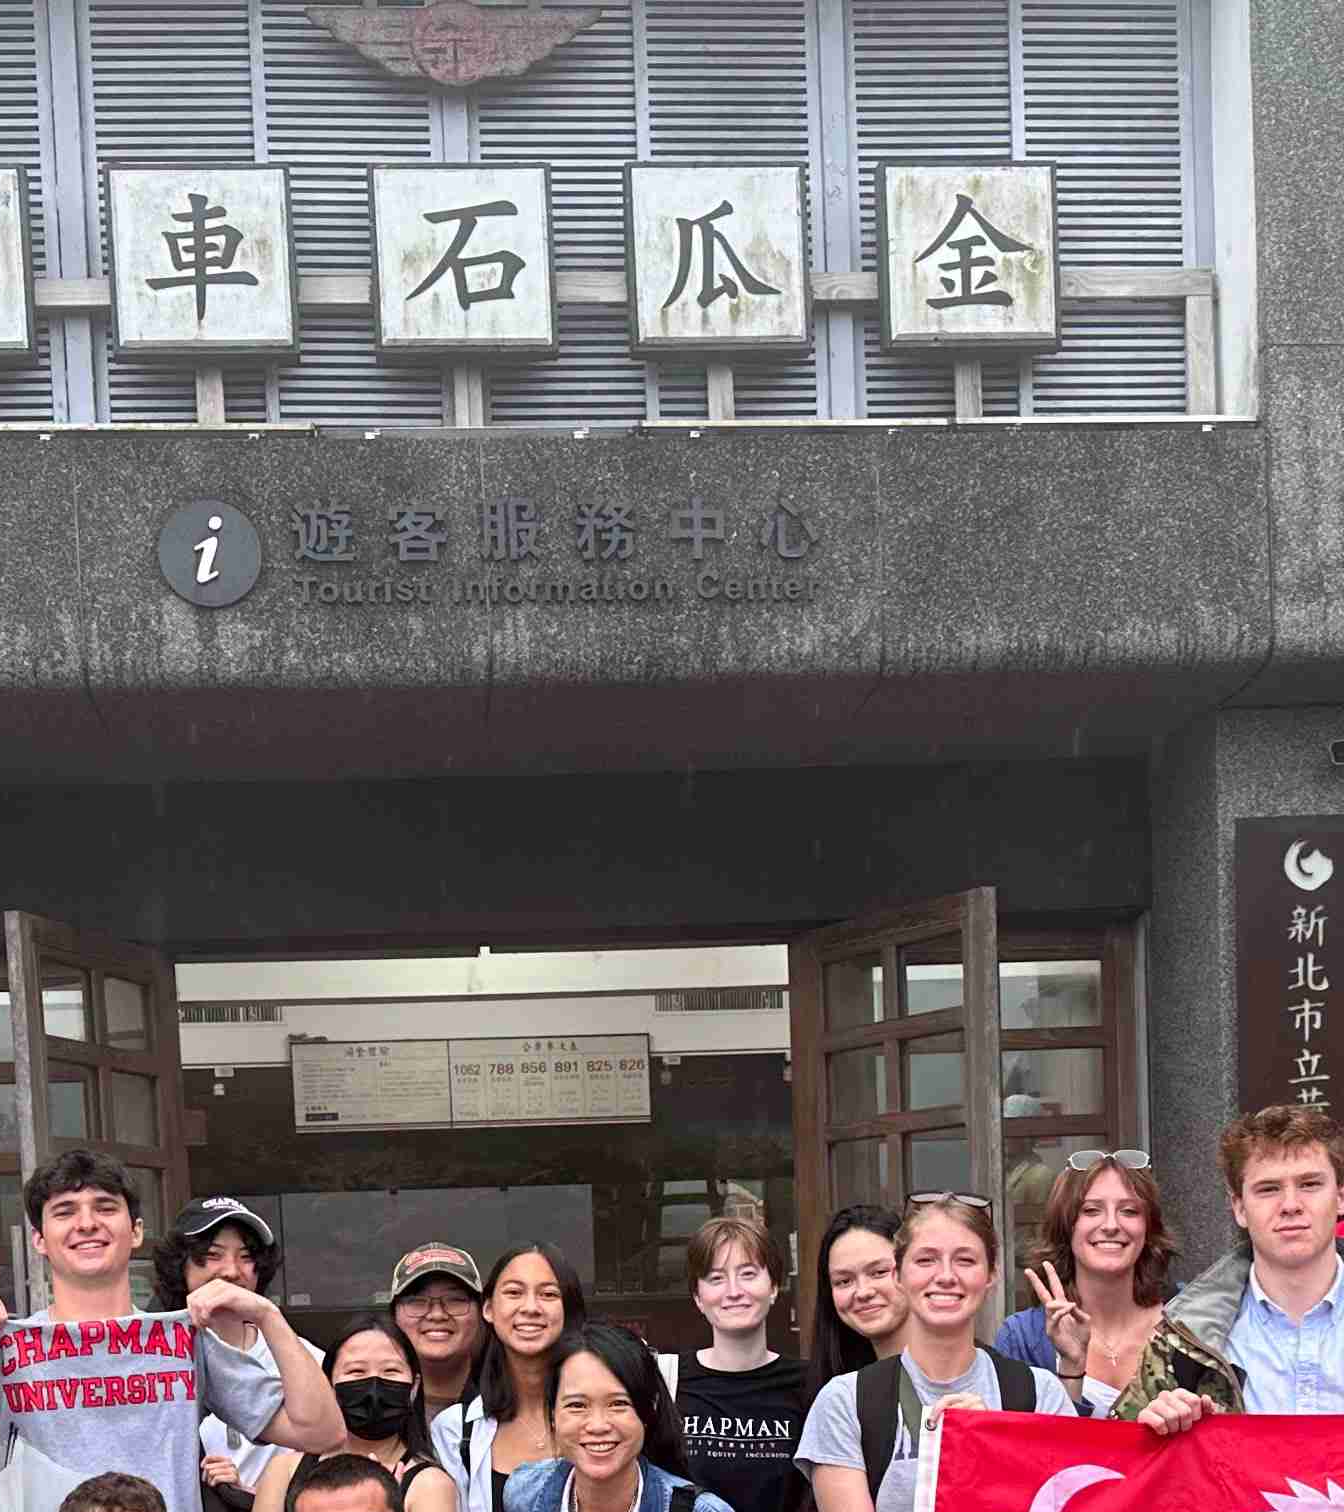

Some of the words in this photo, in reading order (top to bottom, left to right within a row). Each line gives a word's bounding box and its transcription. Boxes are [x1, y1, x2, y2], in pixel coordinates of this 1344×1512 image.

[292, 500, 818, 563] 遊客服務中心
[297, 574, 434, 602] Tourist
[460, 573, 670, 602] Information
[695, 570, 822, 601] Center
[488, 1062, 515, 1075] 788
[554, 1060, 579, 1073] 891
[586, 1059, 614, 1072] 825
[0, 1318, 197, 1377] CHAPMAN
[2, 1369, 197, 1414] UNIVERSITY
[682, 1415, 791, 1438] HAPMAN
